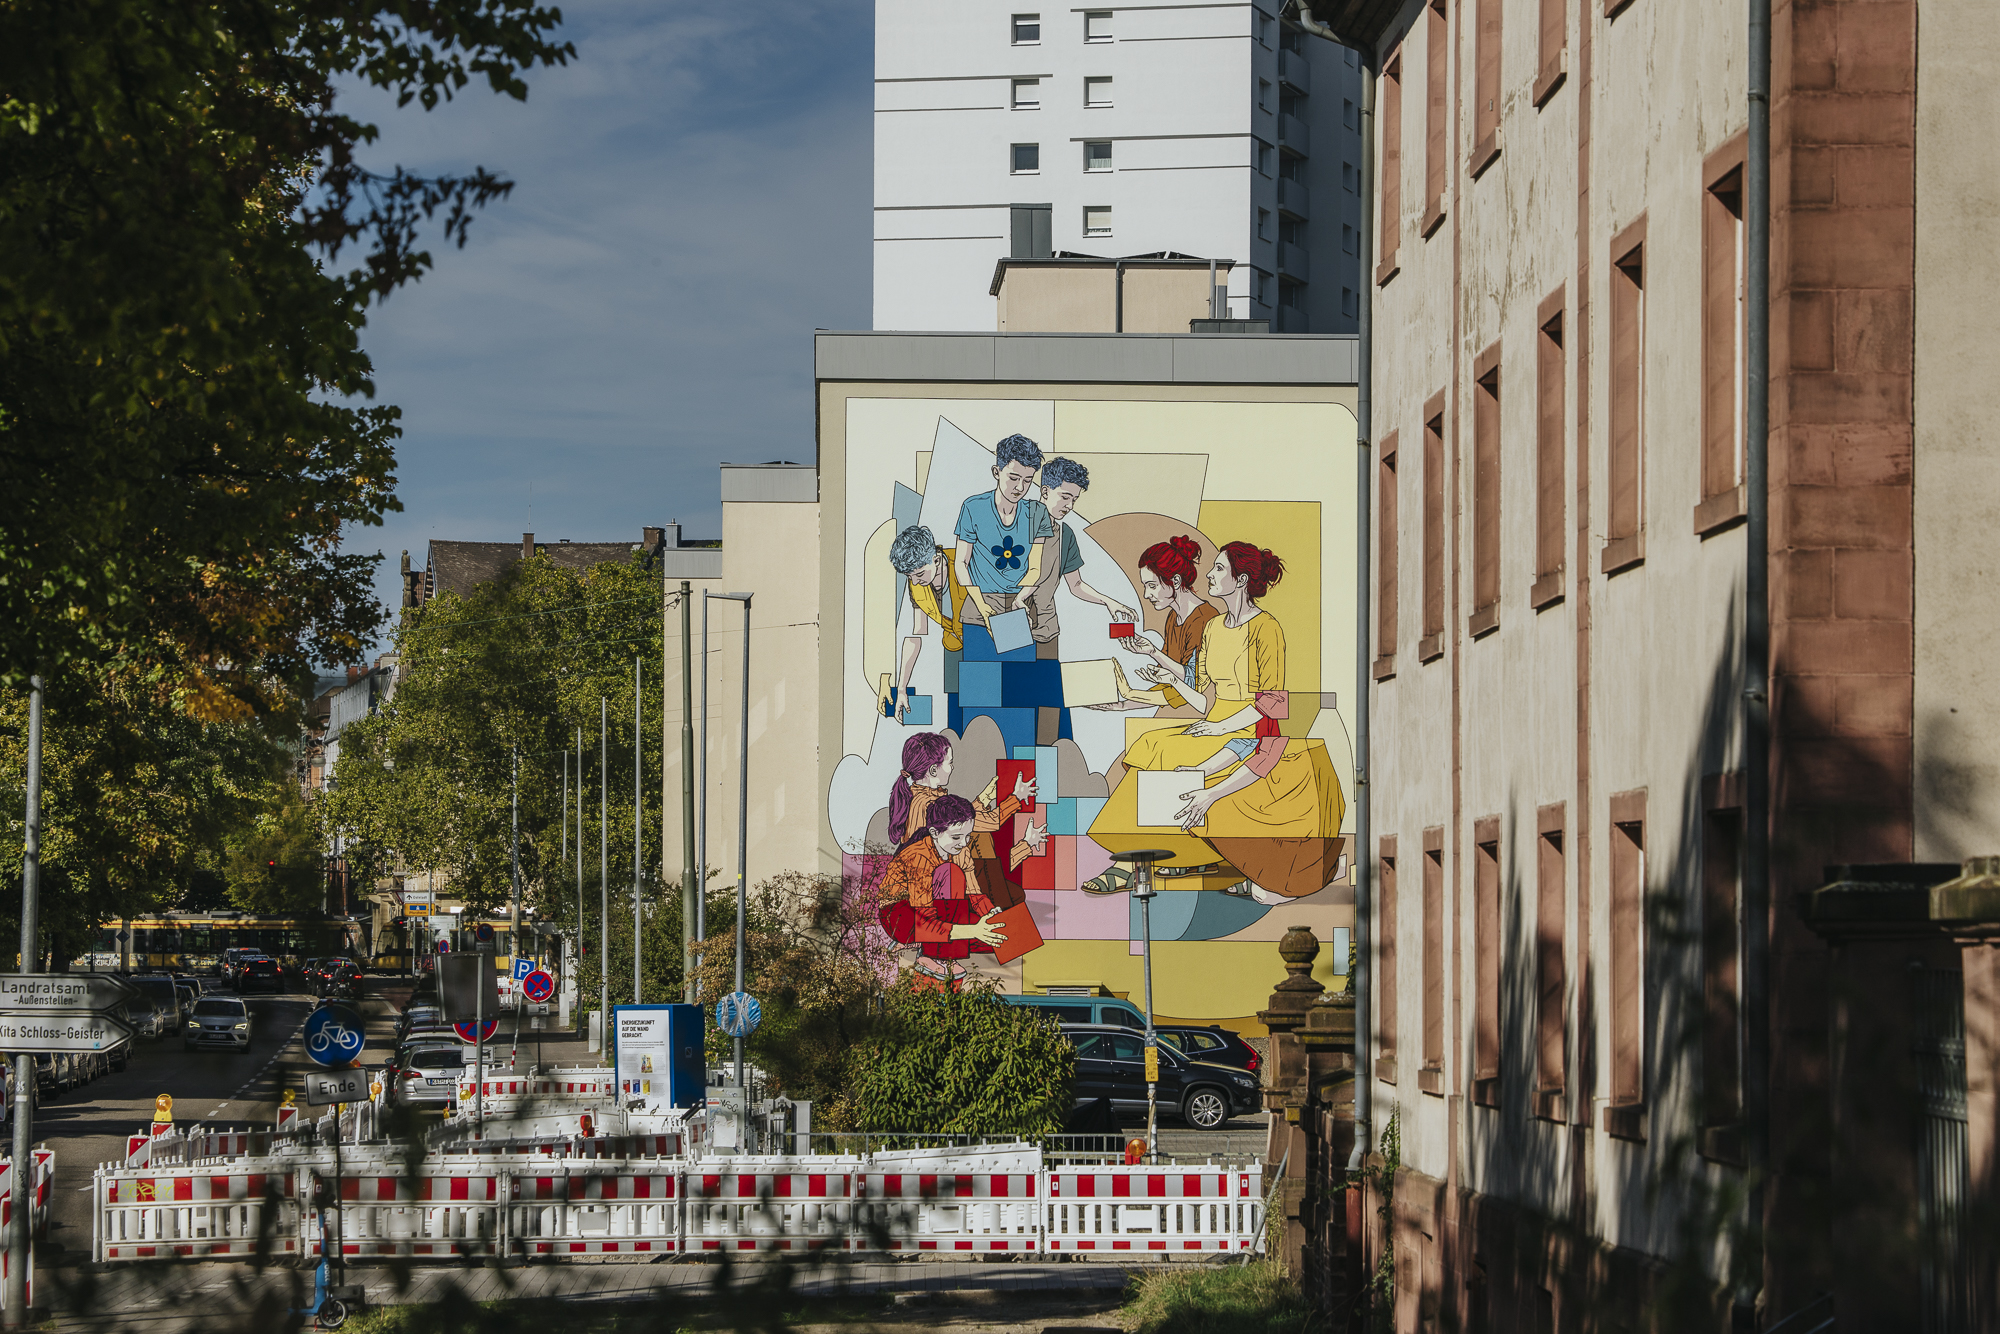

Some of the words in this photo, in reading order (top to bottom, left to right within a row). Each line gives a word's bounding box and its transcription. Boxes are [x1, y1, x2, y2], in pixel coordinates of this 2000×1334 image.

[518, 962, 530, 978] P
[2, 981, 90, 994] Landratsamt
[14, 995, 78, 1005] -Außenstellen-
[20, 1026, 104, 1039] Schloss-Geister
[319, 1079, 356, 1095] Ende
